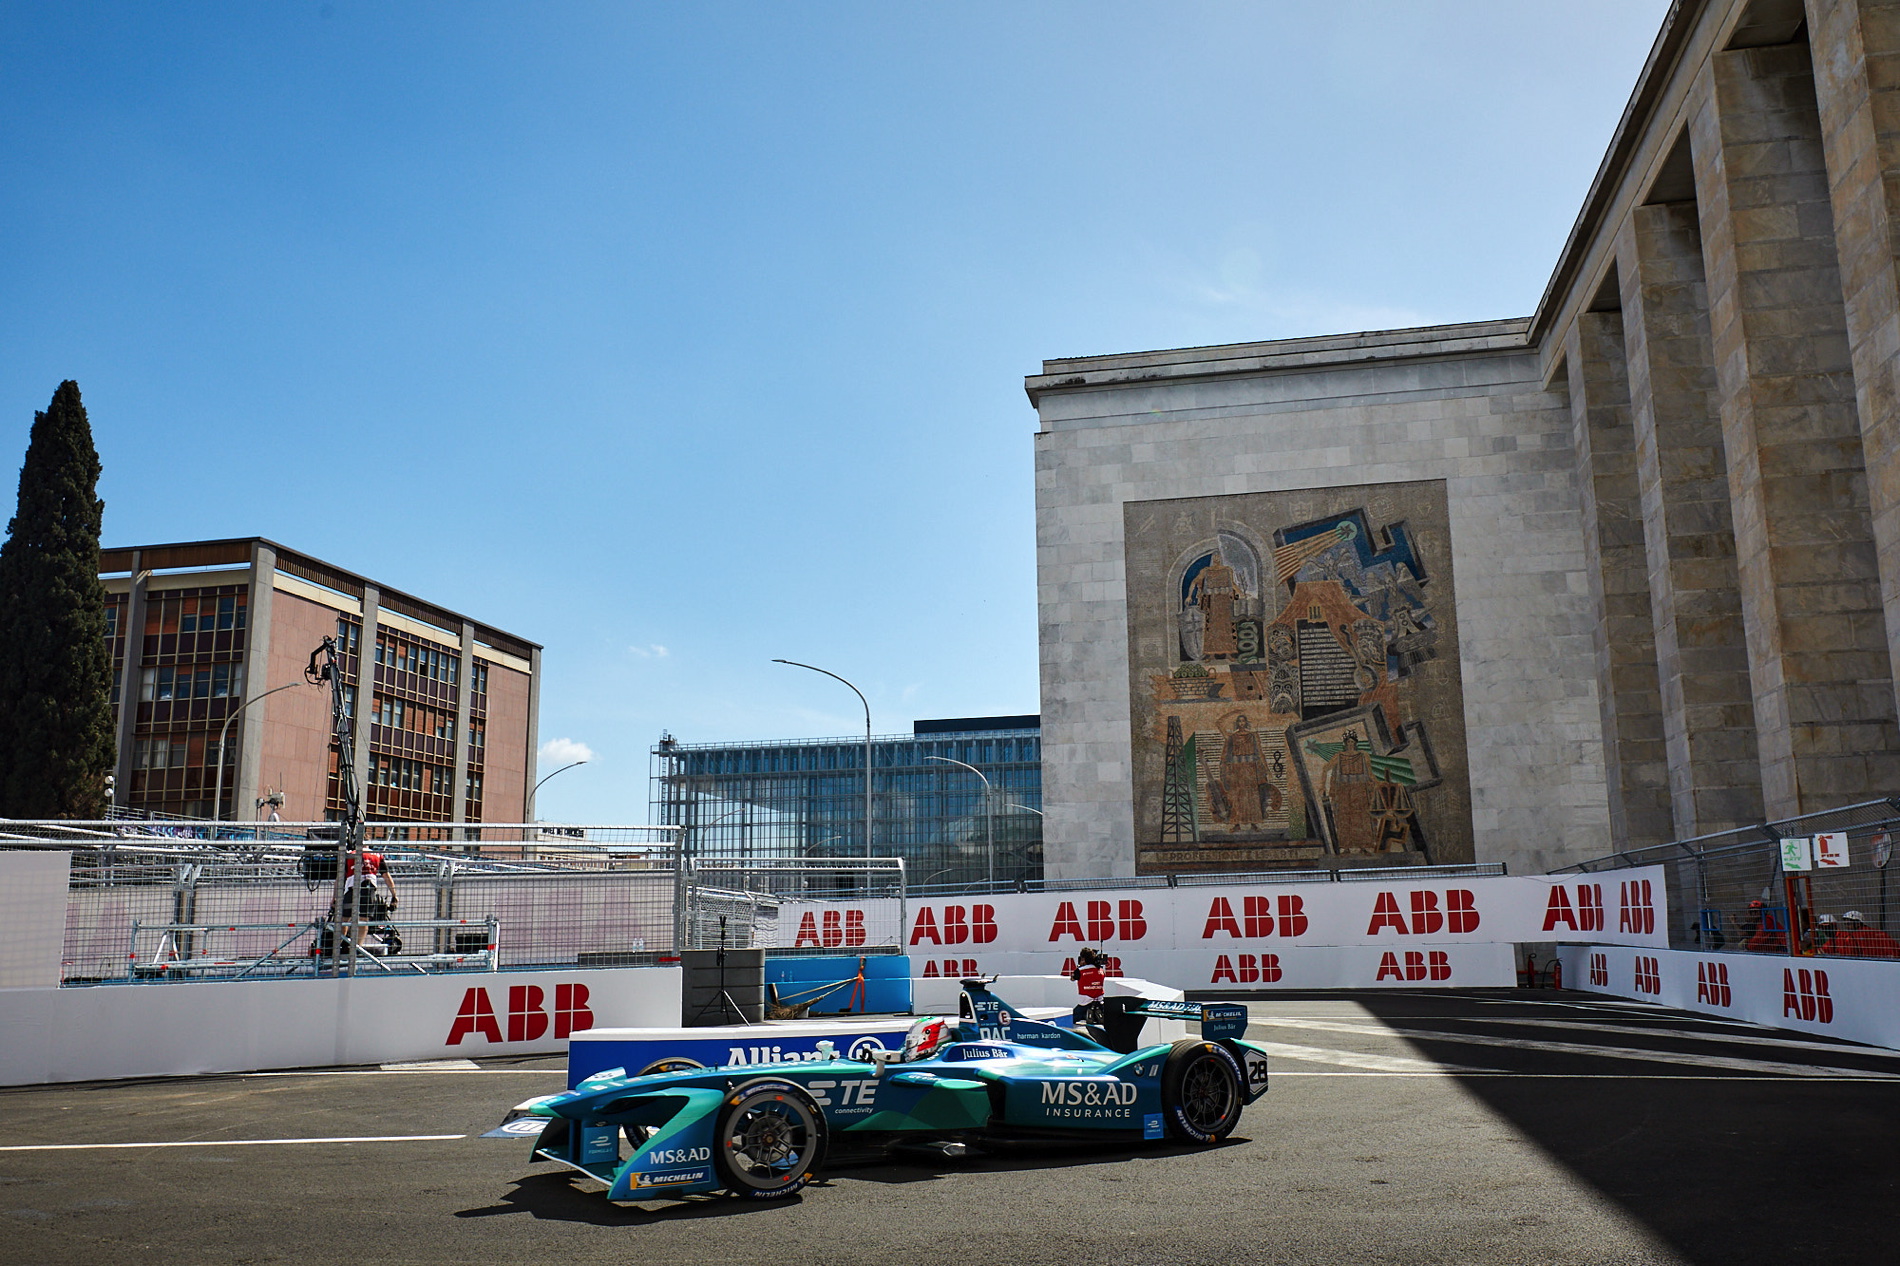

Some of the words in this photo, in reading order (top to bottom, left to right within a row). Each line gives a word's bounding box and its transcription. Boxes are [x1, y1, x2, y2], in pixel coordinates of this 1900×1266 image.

[909, 903, 998, 946] ABB
[1048, 899, 1148, 942] ABB
[1202, 894, 1309, 939] ABB
[1367, 889, 1480, 936] ABB
[1542, 885, 1604, 931] ABB
[1620, 879, 1655, 934] ABB
[795, 909, 866, 948] ABB
[1211, 953, 1283, 984] ABB
[1376, 950, 1452, 981] ABB
[1590, 953, 1608, 987] ABB
[1635, 955, 1661, 995] ABB
[1698, 961, 1732, 1008] ABB
[1784, 967, 1834, 1024] ABB
[445, 983, 594, 1046] ABB
[963, 1048, 991, 1060] Julius
[992, 1048, 1008, 1058] Bär
[1017, 1032, 1039, 1040] harman
[1041, 1032, 1061, 1040] kardon
[1249, 1061, 1268, 1084] 28
[1041, 1081, 1138, 1106] MS&AD
[1046, 1107, 1131, 1118] INSURANCE
[650, 1147, 711, 1165] MS&AD
[653, 1172, 705, 1184] MICHELIN
[754, 1183, 799, 1198] MICHELIN
